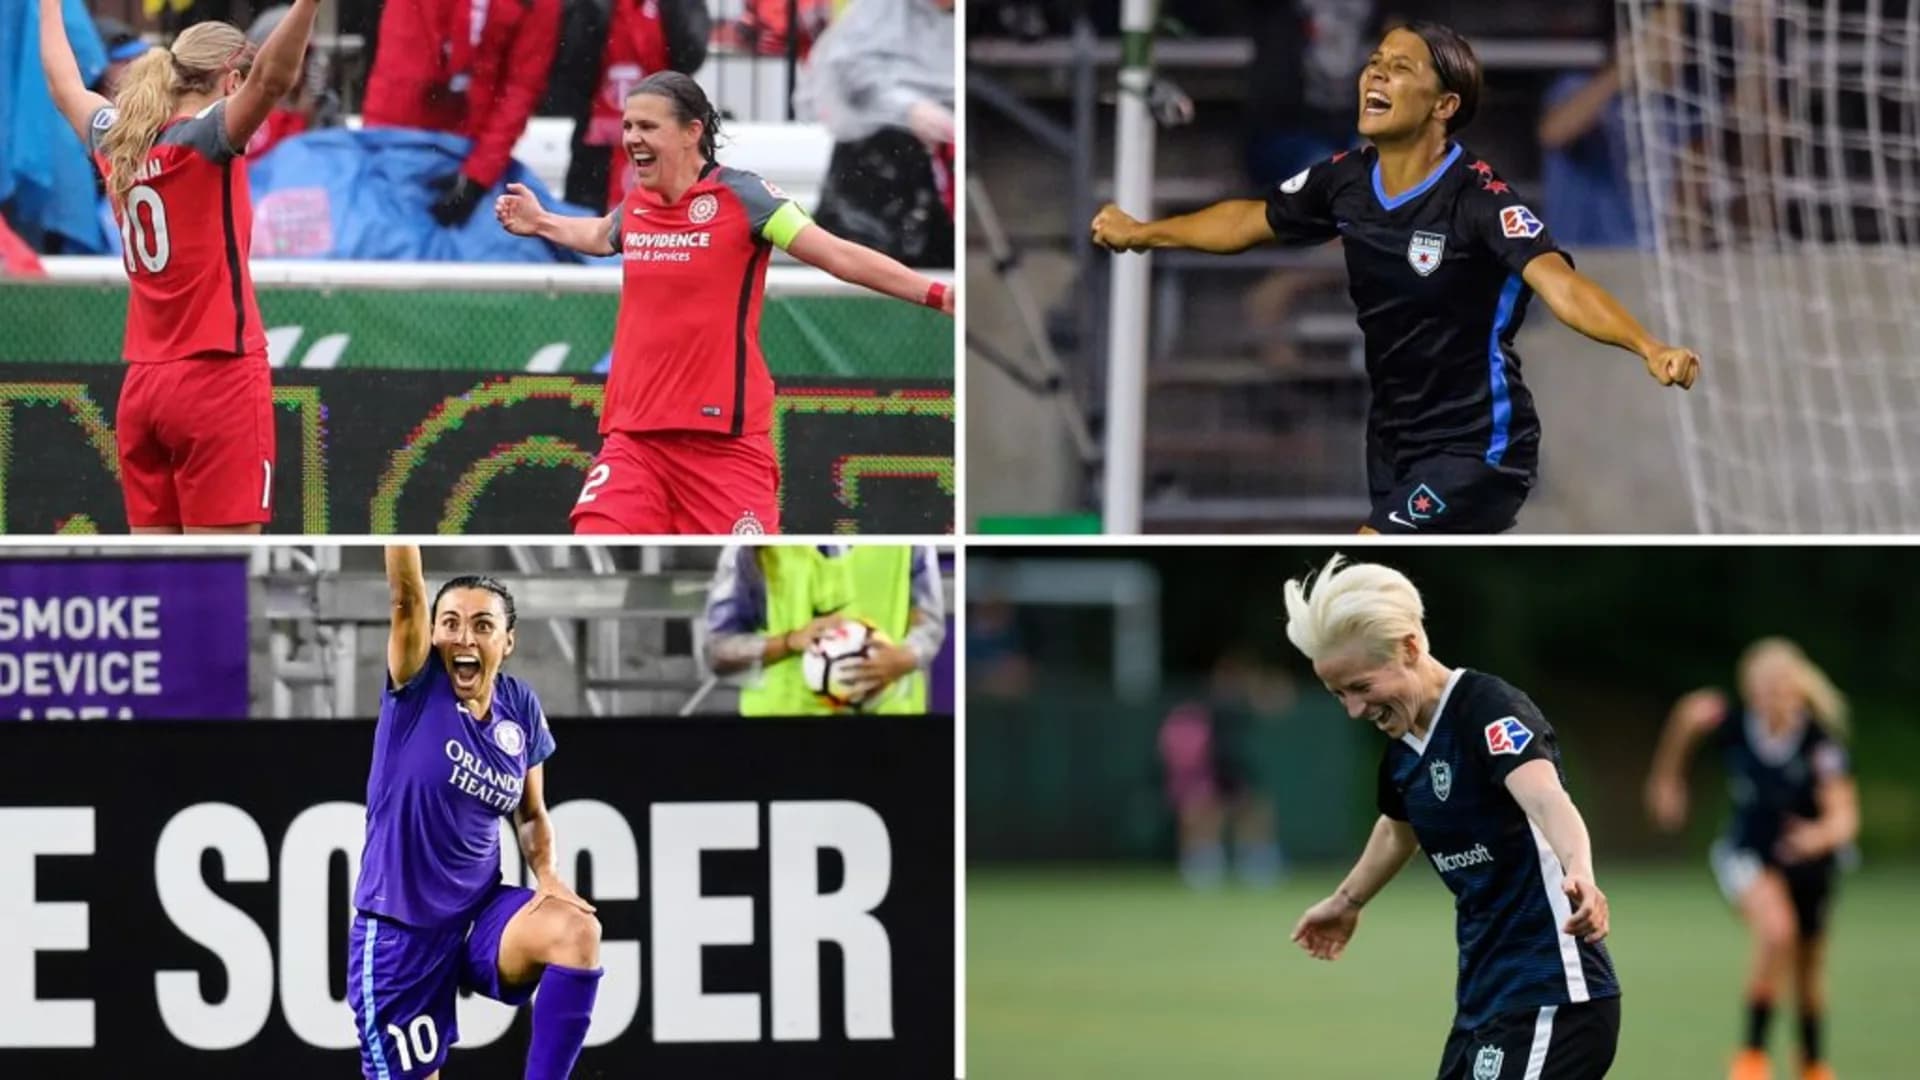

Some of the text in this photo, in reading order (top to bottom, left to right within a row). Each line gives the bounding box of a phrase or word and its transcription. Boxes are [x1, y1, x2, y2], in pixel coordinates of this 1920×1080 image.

[122, 185, 170, 273] 10
[625, 232, 711, 248] PROVIDENCE
[0, 596, 161, 641] SMOKE
[1431, 843, 1494, 873] Microsoft
[387, 1014, 439, 1072] 10
